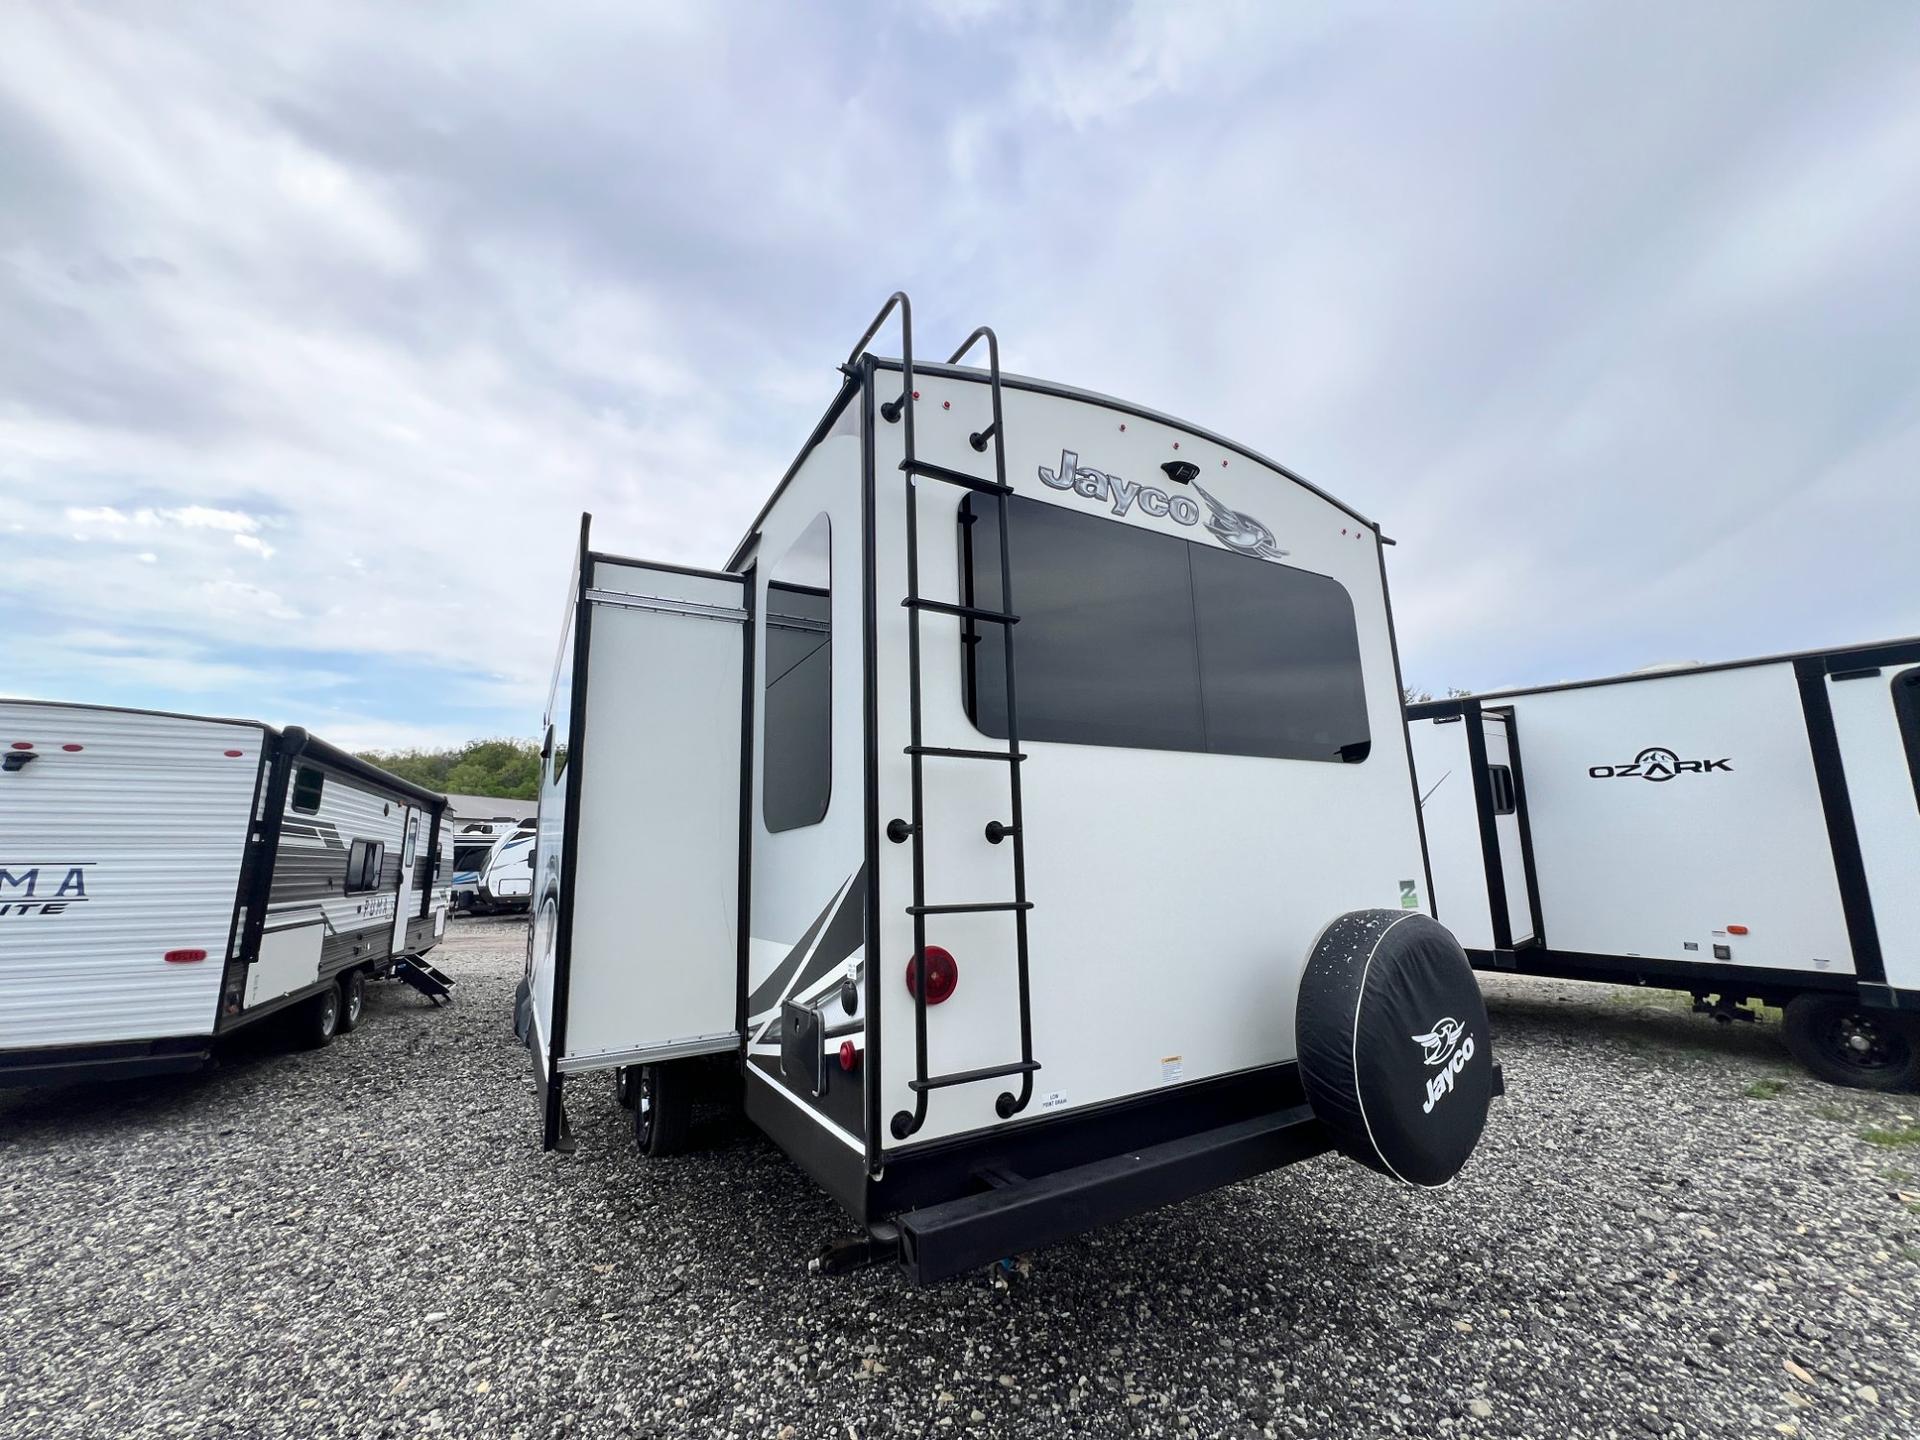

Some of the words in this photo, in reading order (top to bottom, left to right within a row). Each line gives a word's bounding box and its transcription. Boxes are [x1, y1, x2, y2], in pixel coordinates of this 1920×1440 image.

[1038, 449, 1199, 526] Jayco
[1588, 753, 1734, 781] OZARK
[1422, 1036, 1475, 1114] Jayco
